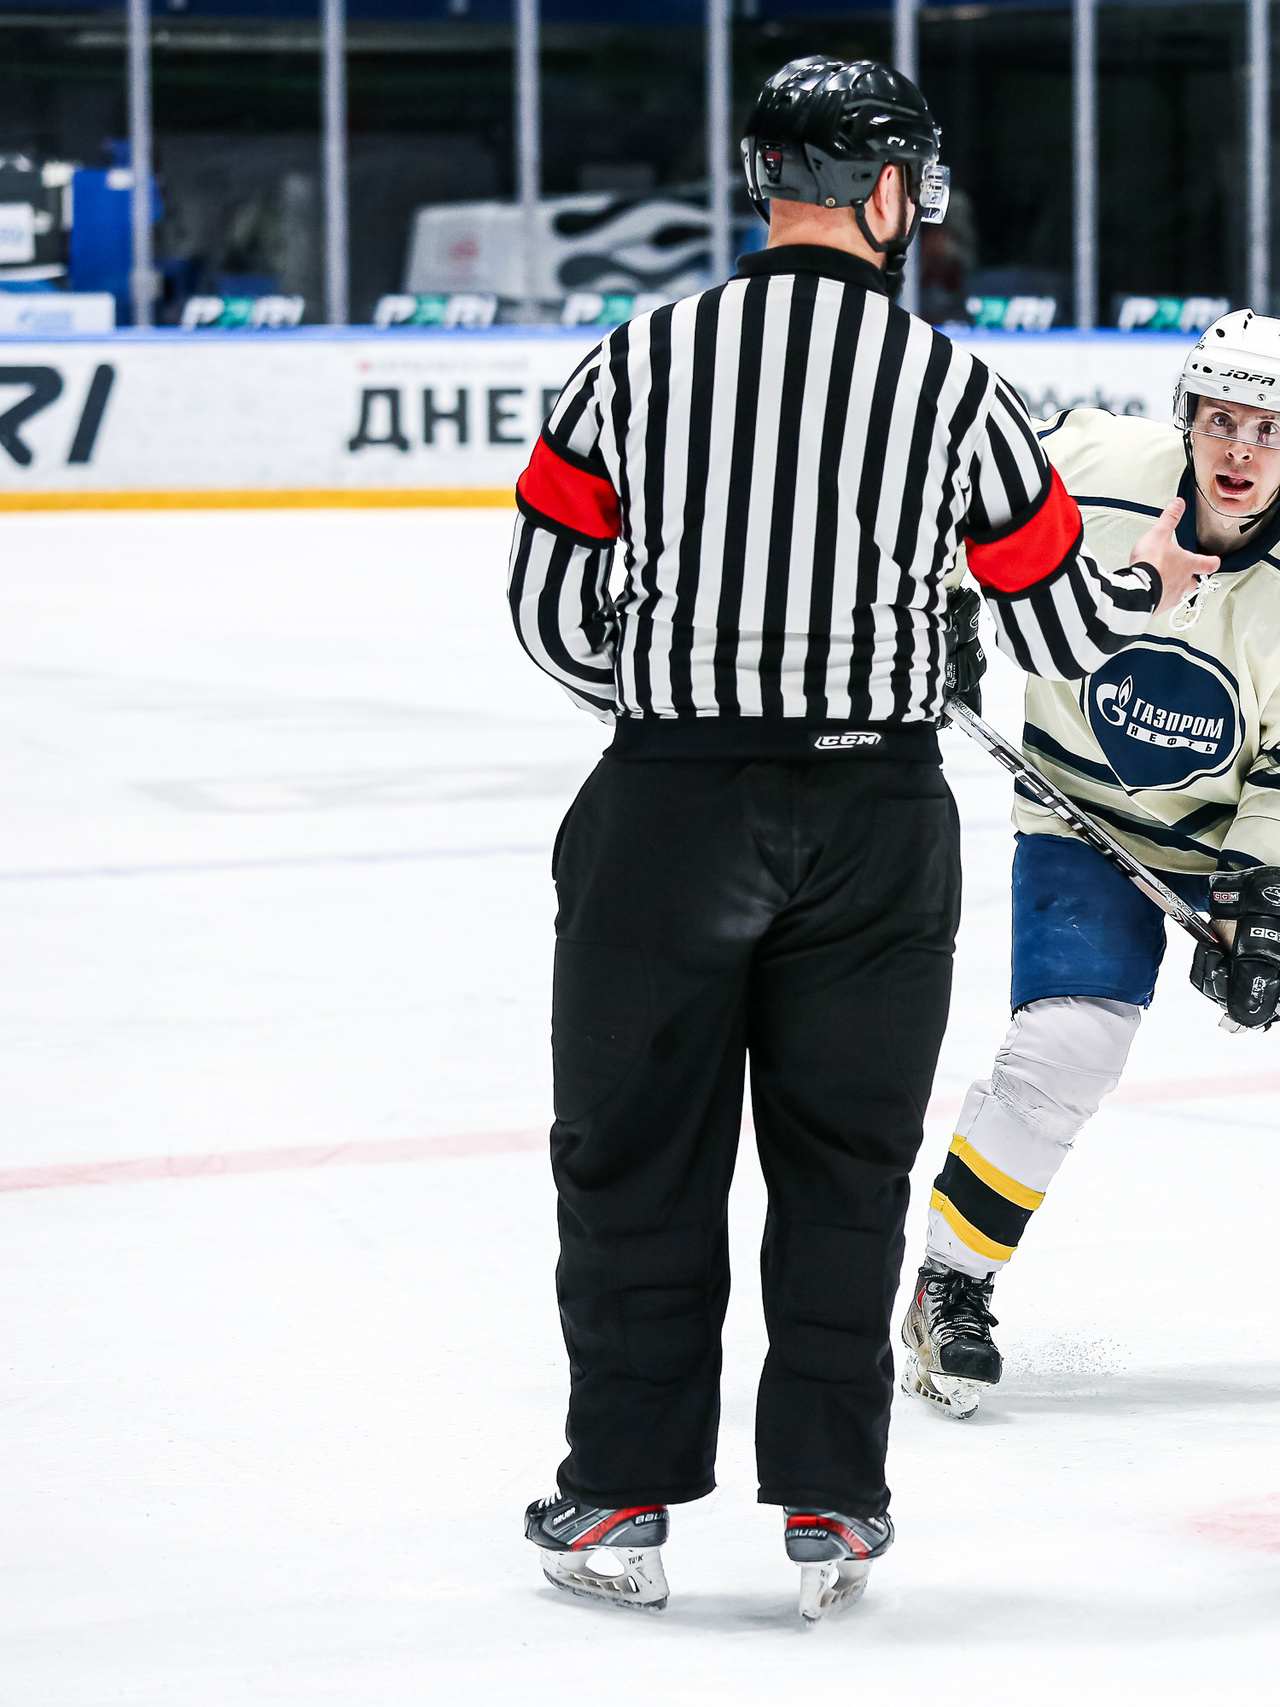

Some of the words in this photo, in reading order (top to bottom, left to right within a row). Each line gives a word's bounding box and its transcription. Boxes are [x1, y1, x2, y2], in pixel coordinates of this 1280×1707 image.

[1220, 370, 1275, 386] JOFA
[1131, 697, 1225, 740] ГАЗПРОМ
[818, 733, 878, 747] CCM
[1130, 725, 1213, 752] НЕФТЬ
[1213, 891, 1240, 901] CCM
